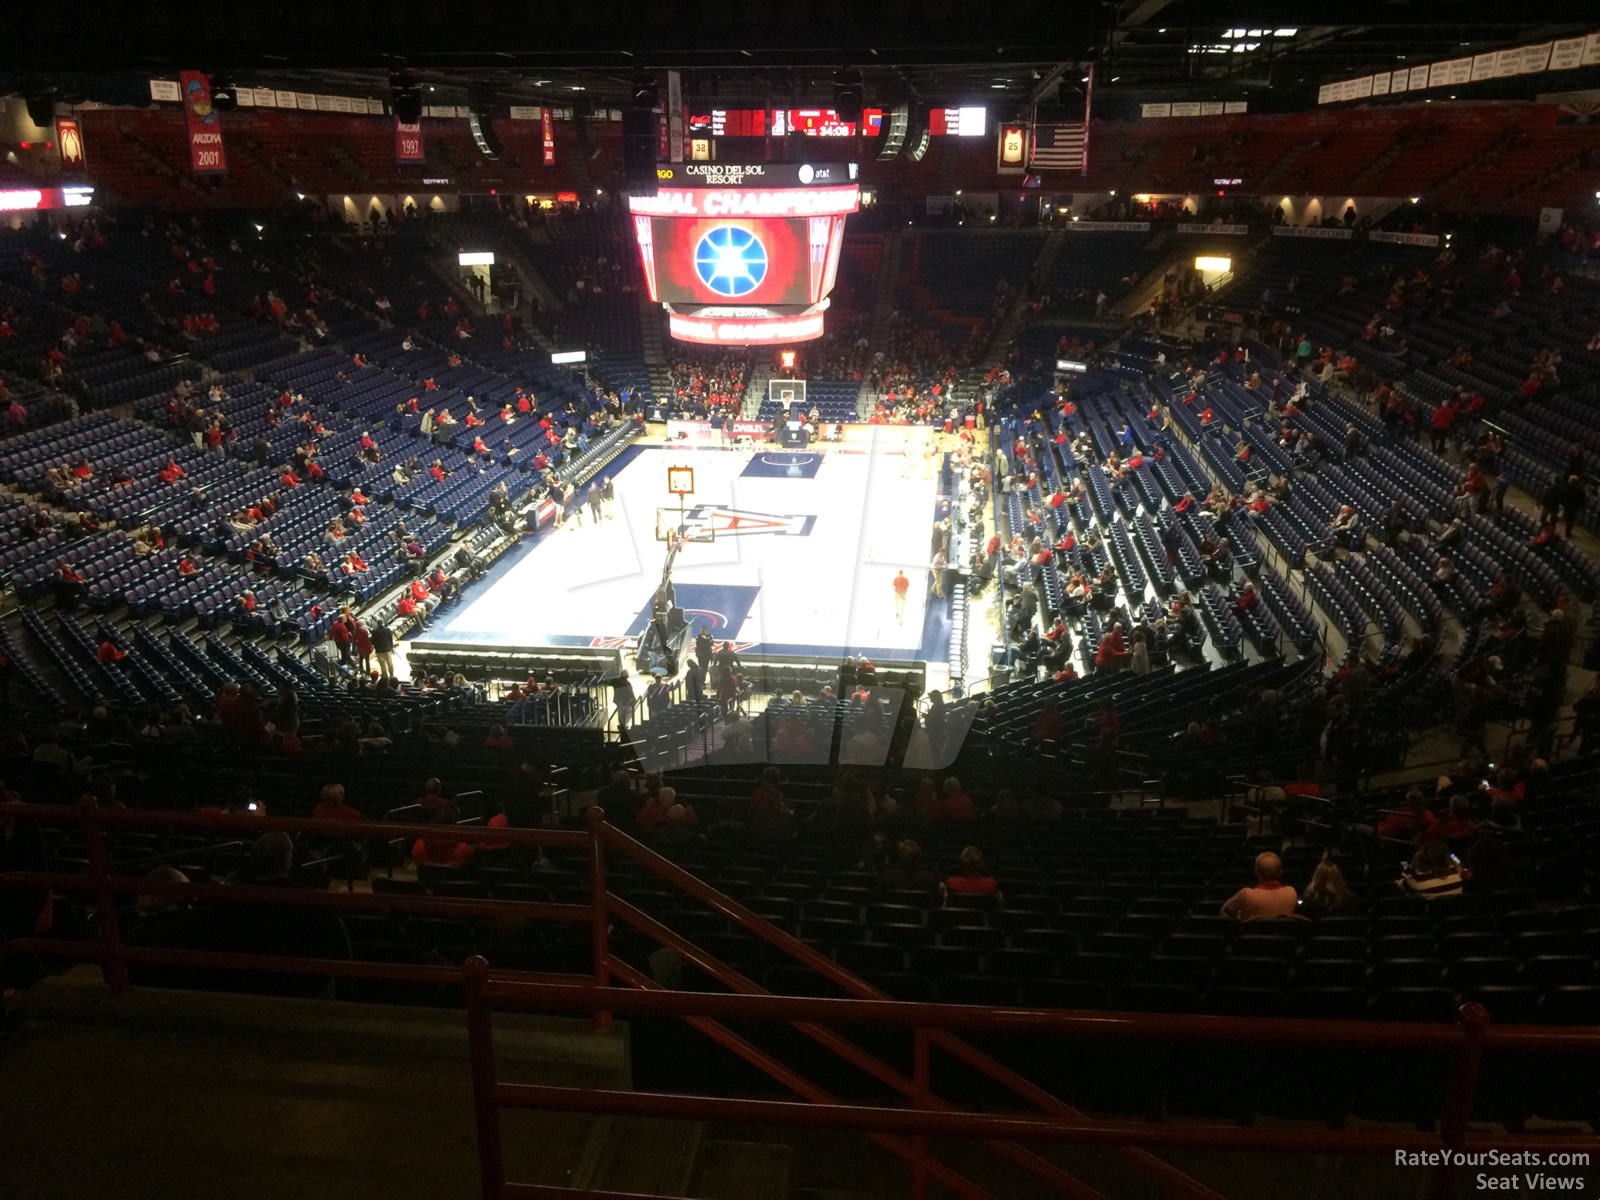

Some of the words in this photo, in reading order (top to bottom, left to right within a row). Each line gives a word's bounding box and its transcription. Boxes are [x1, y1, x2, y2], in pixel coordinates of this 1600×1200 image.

[193, 133, 221, 144] ARIZONA
[402, 140, 419, 154] 1997
[696, 143, 706, 152] 32
[1008, 142, 1018, 151] 25
[198, 151, 219, 166] 2001
[686, 165, 724, 175] CASINO
[725, 165, 744, 175] DEL
[745, 165, 765, 175] SOL
[706, 174, 744, 185] RESORT
